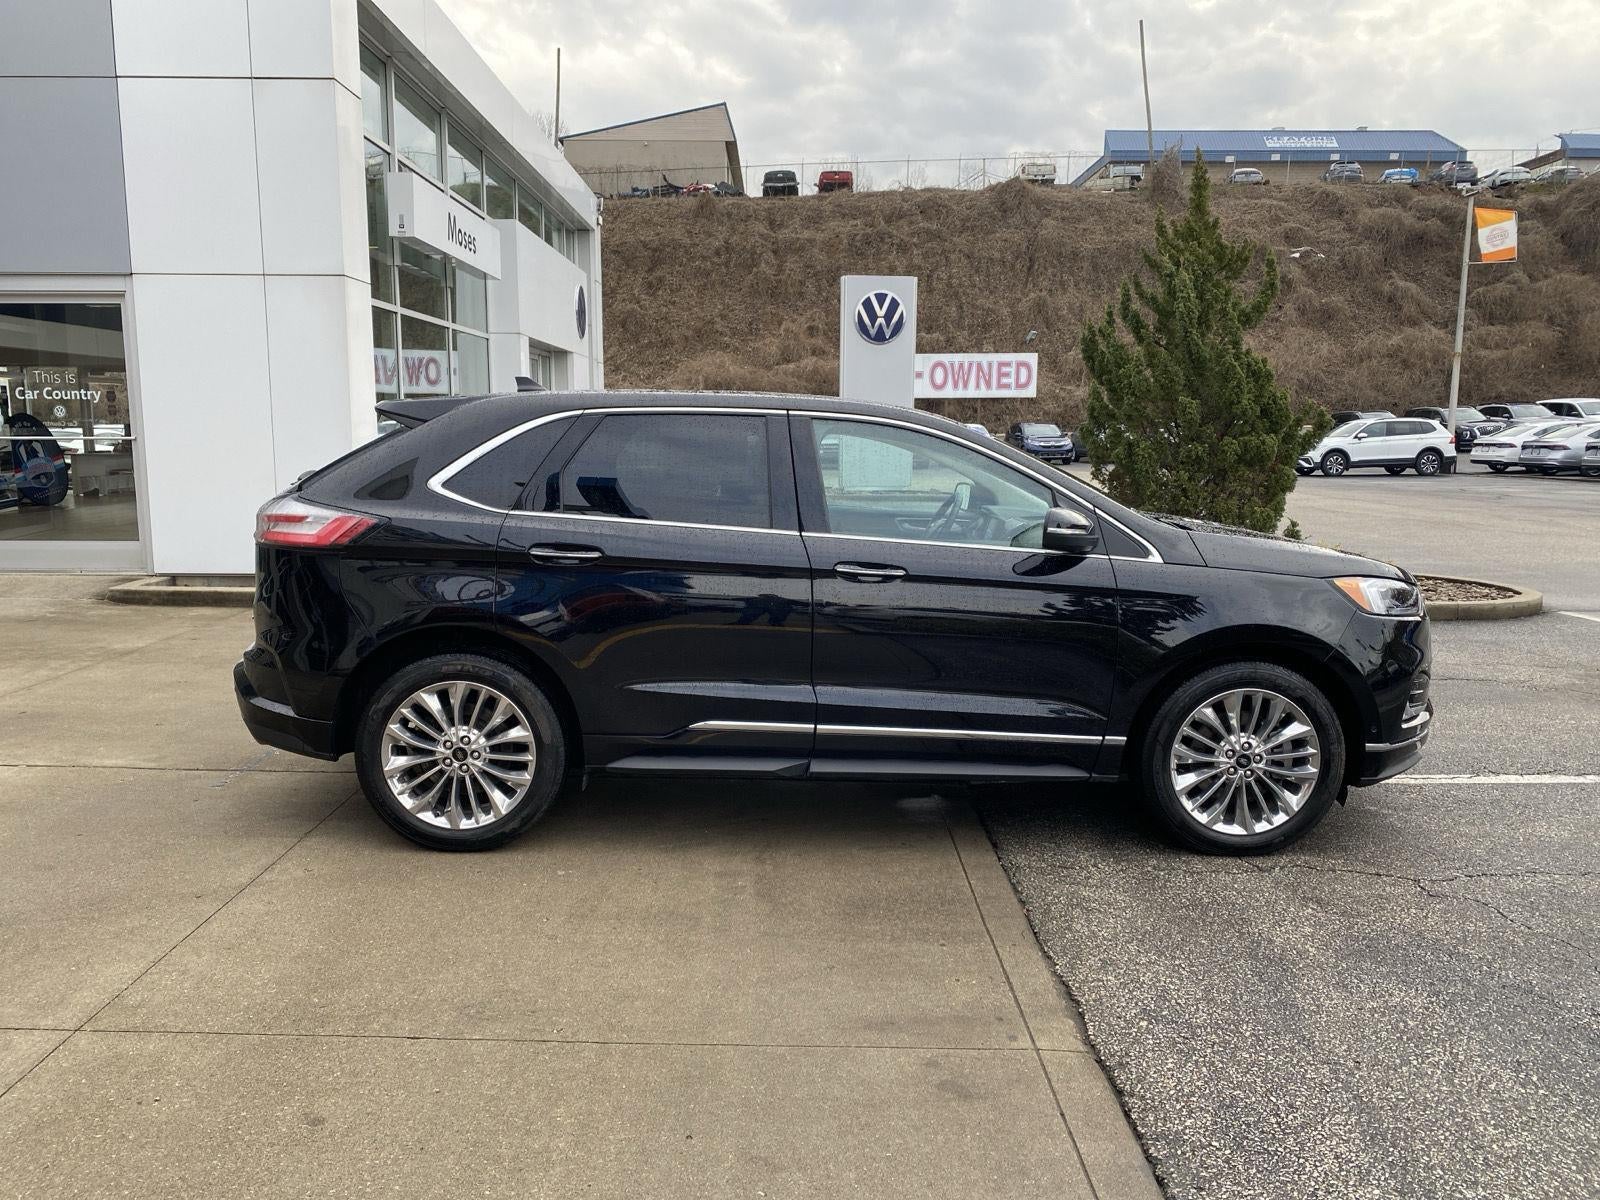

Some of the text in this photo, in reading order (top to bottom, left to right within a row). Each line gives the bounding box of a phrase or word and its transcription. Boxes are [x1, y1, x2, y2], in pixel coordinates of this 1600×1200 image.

[447, 212, 477, 254] Moses
[32, 371, 76, 384] This is
[15, 387, 101, 403] Car Country
